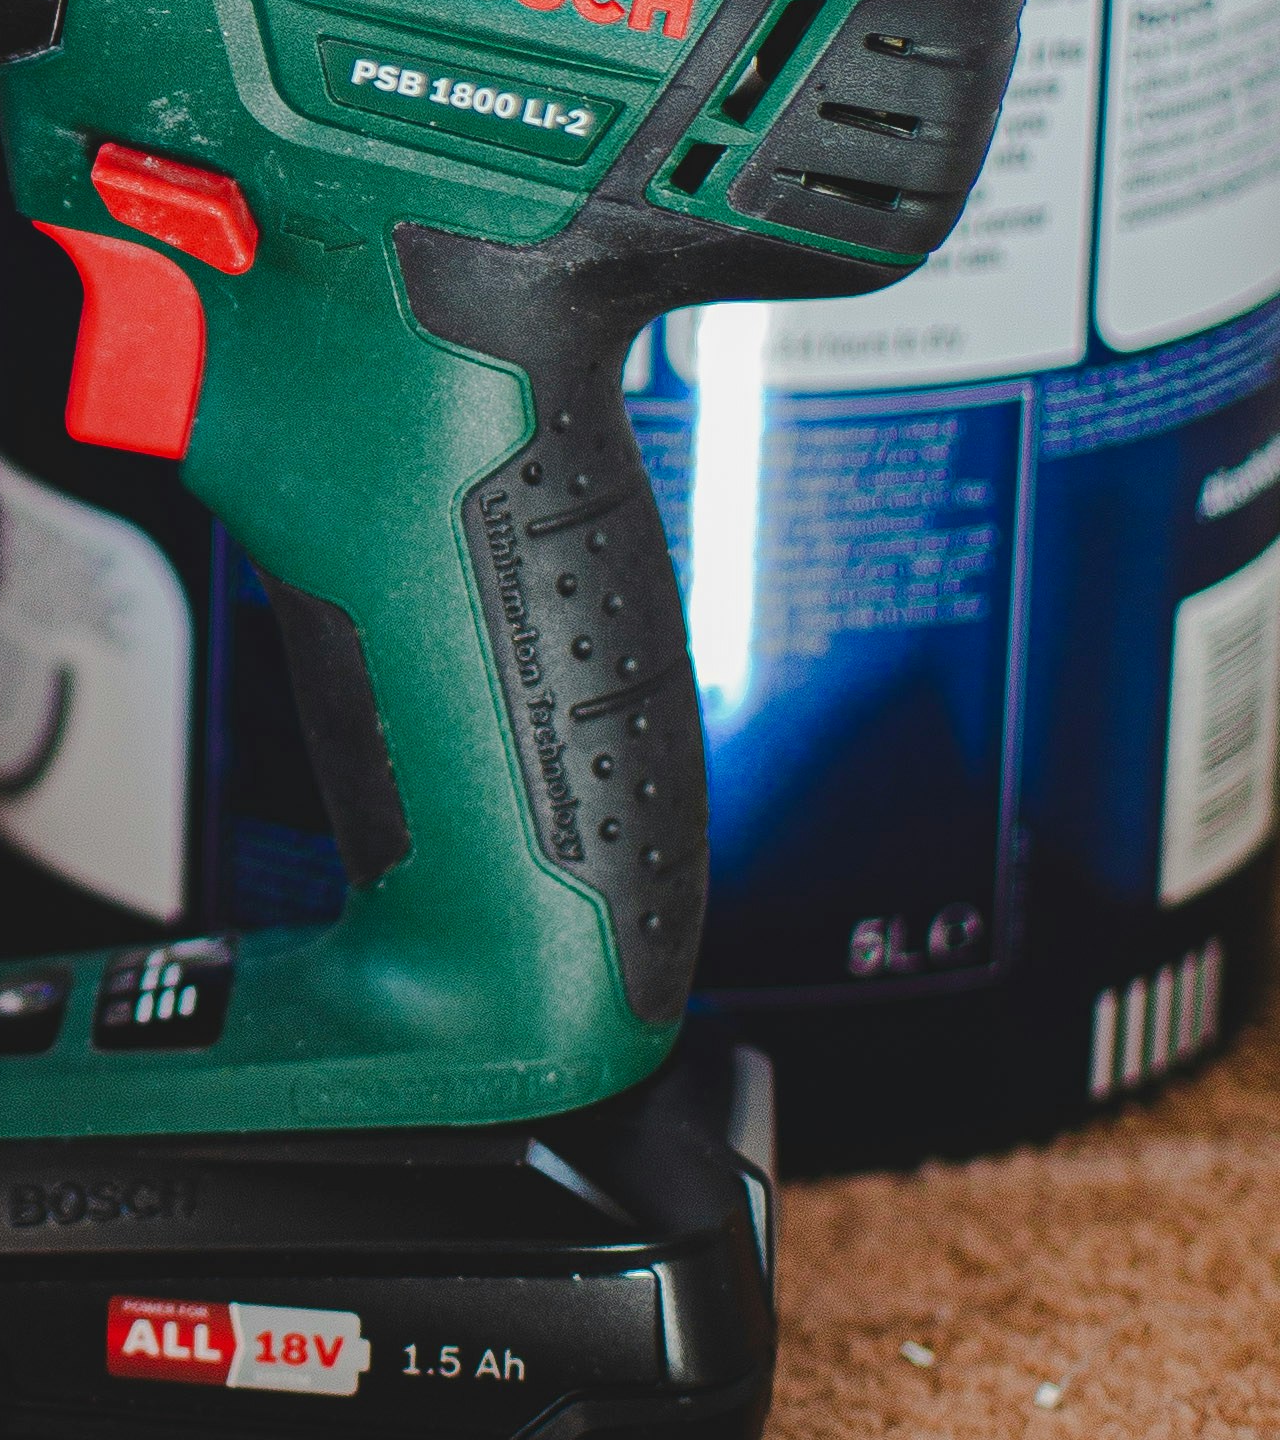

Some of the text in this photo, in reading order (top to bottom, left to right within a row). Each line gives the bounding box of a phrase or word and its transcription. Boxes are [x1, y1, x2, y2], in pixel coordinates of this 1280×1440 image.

[351, 58, 596, 138] PSB 1800 LI-2
[480, 490, 586, 863] Lithium-Ion Technology
[9, 1180, 201, 1229] BOSCH
[122, 1299, 209, 1318] POWER FOR
[121, 1317, 224, 1365] ALL
[254, 1329, 344, 1370] 18V
[402, 1343, 527, 1382] 1.5 Ah
